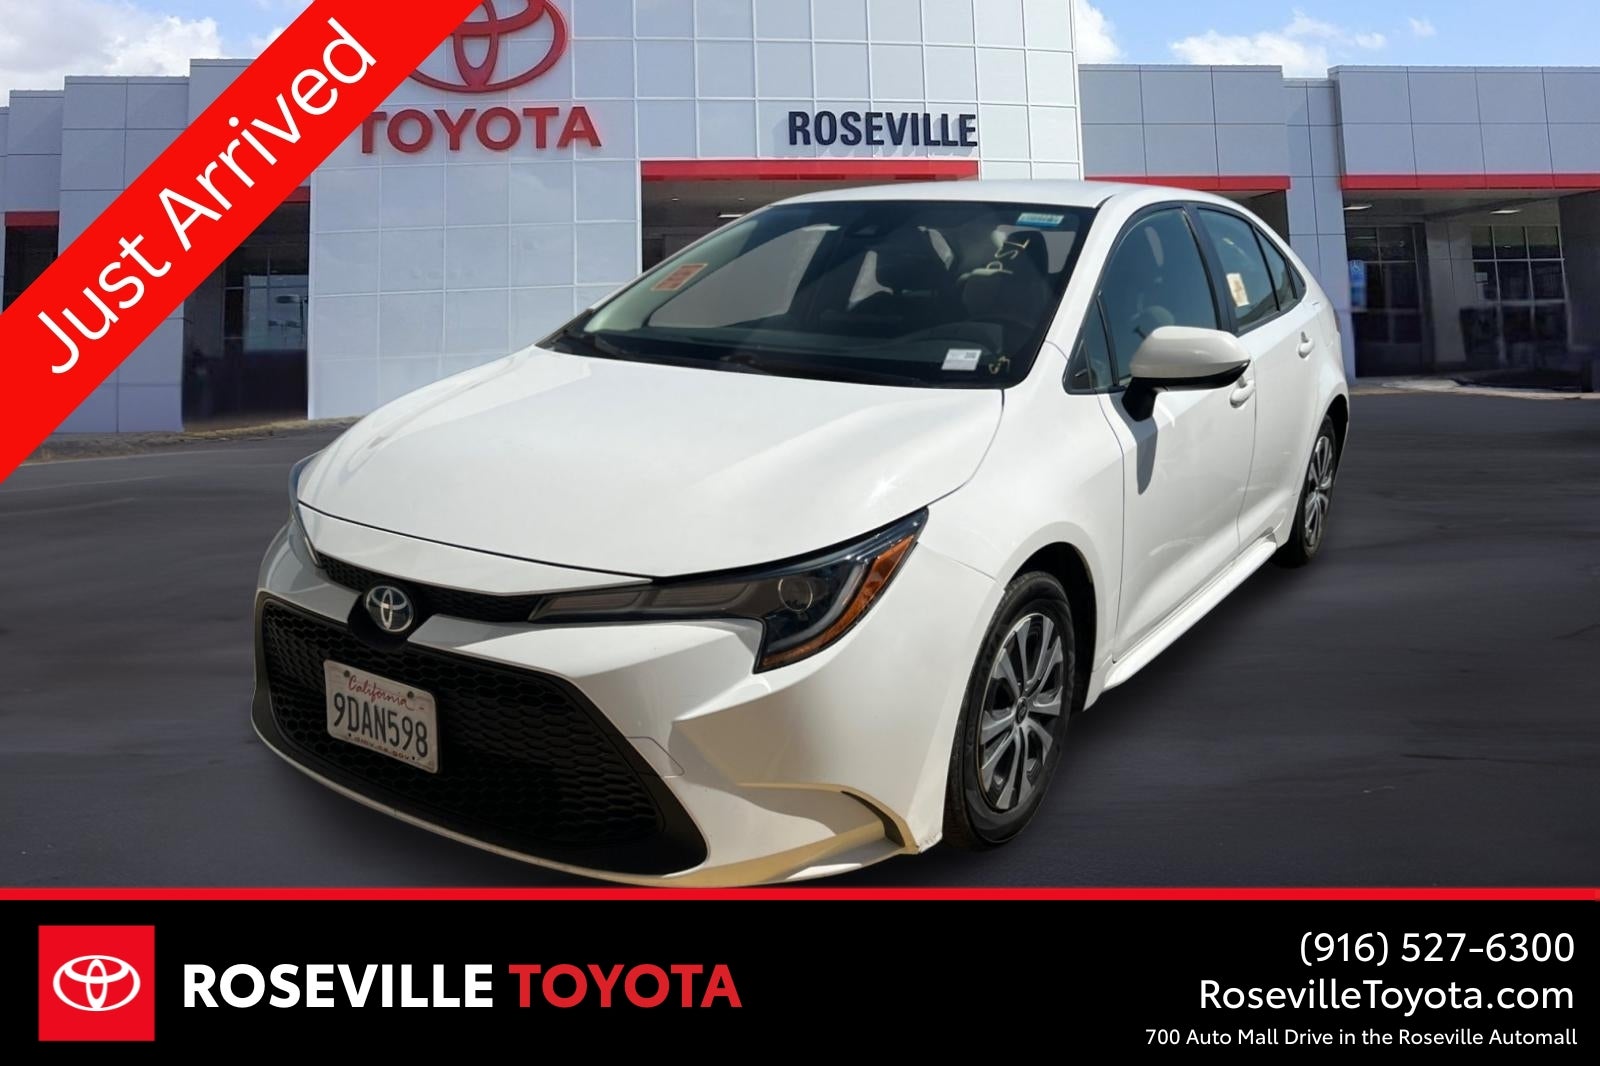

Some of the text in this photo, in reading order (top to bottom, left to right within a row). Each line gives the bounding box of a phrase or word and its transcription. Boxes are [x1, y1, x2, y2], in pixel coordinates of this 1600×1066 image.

[361, 106, 602, 154] TOYOTA
[788, 111, 978, 147] ROSEVILLE
[348, 675, 414, 711] California
[334, 692, 428, 758] 9DAN598
